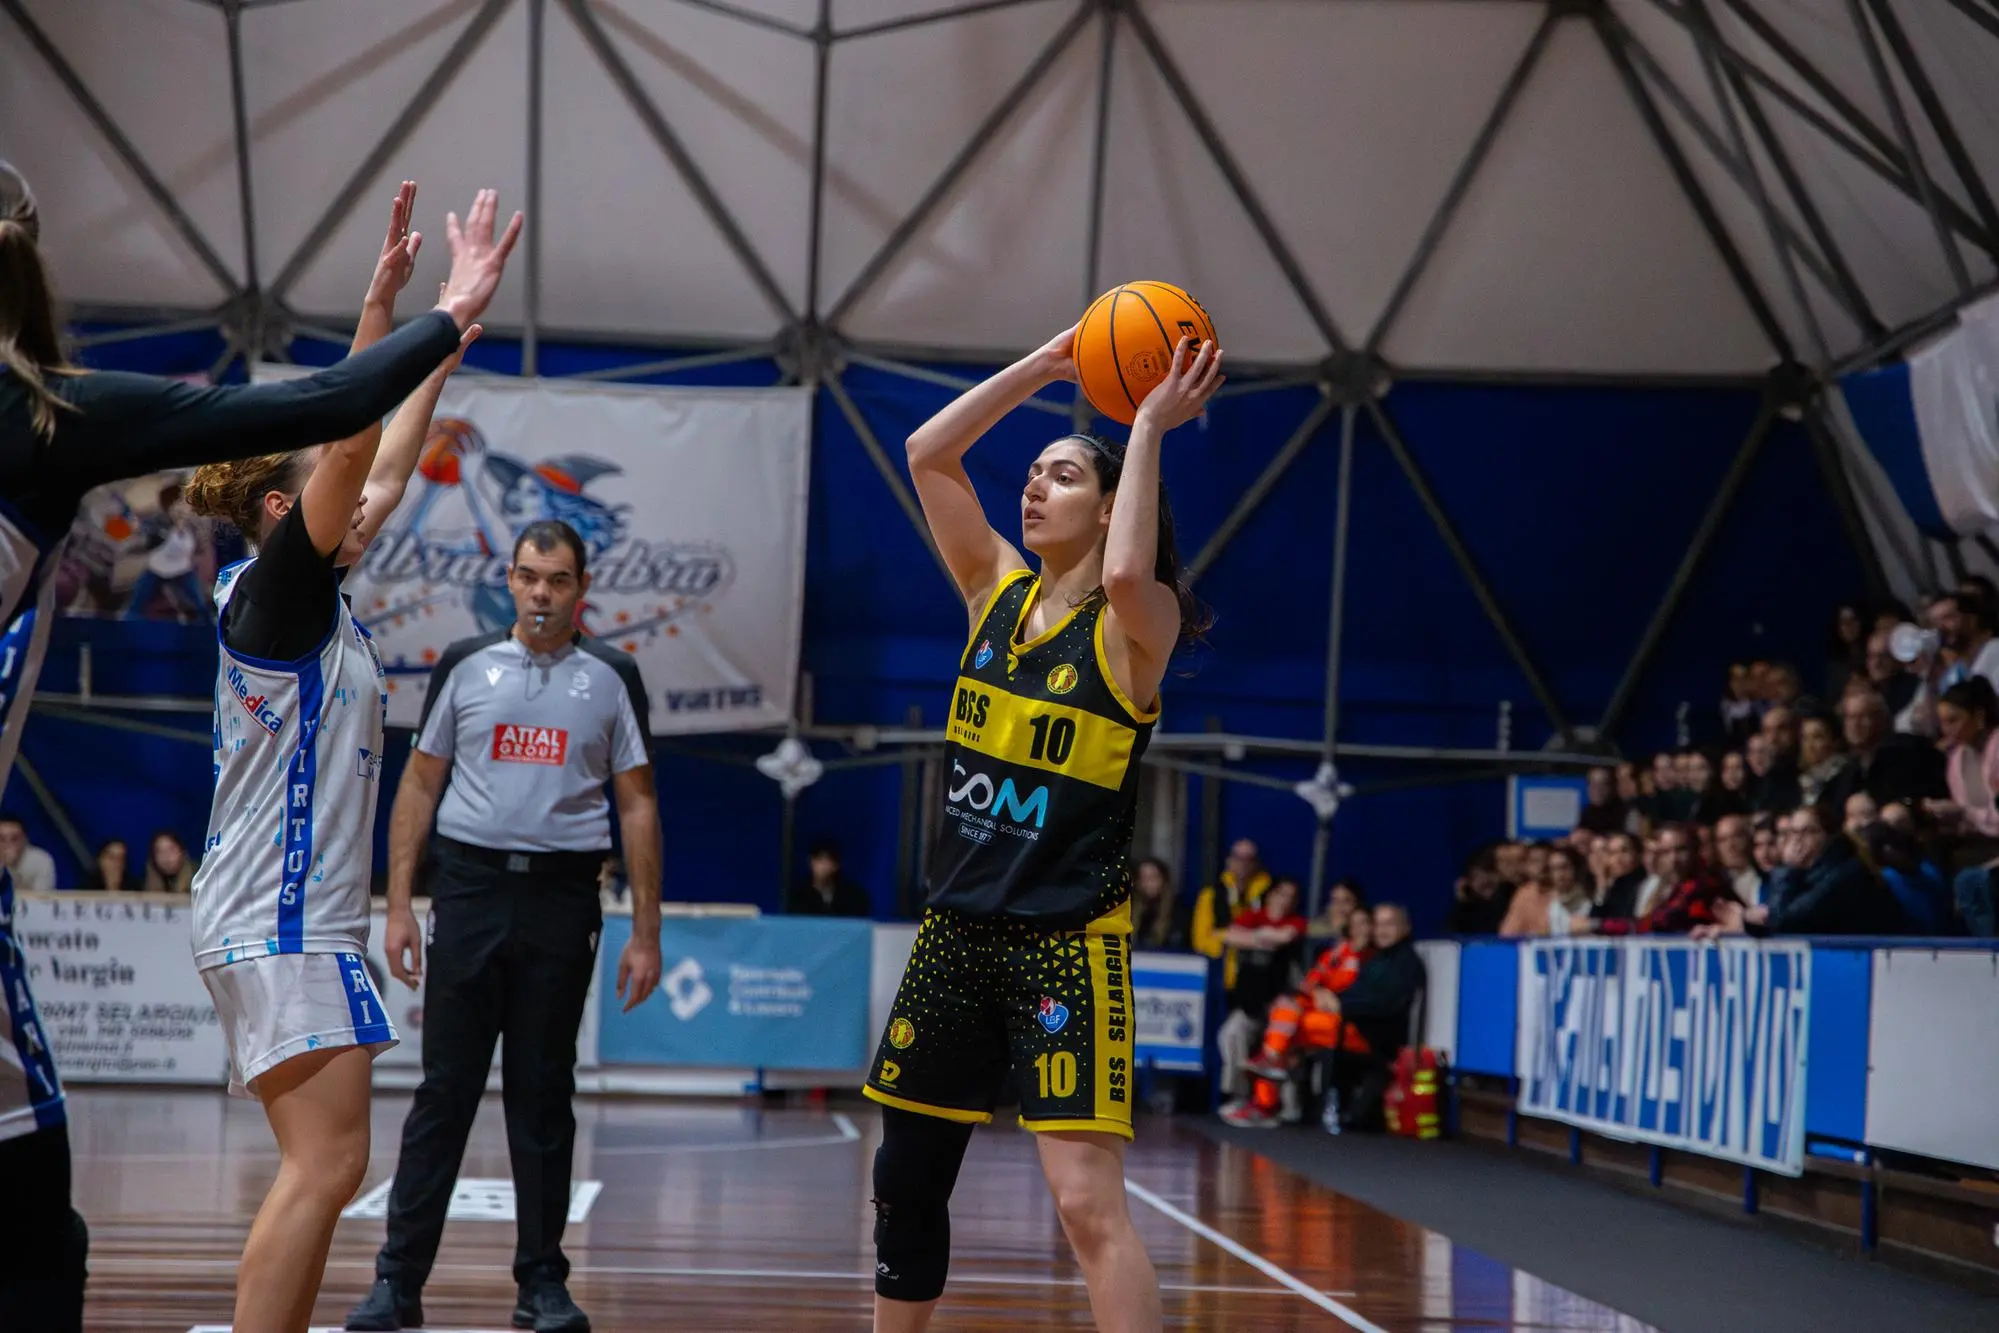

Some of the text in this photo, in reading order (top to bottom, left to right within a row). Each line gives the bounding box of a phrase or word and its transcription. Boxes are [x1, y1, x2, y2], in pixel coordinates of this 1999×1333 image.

[955, 688, 990, 729] BSS
[500, 742, 560, 758] GROUP
[502, 726, 560, 748] ATTAL
[1029, 713, 1076, 766] 10
[961, 825, 978, 839] SINCE
[1000, 824, 1039, 841] SOLUTIONS
[1103, 934, 1126, 1104] BSS SELARGIU
[1034, 1051, 1077, 1098] 10
